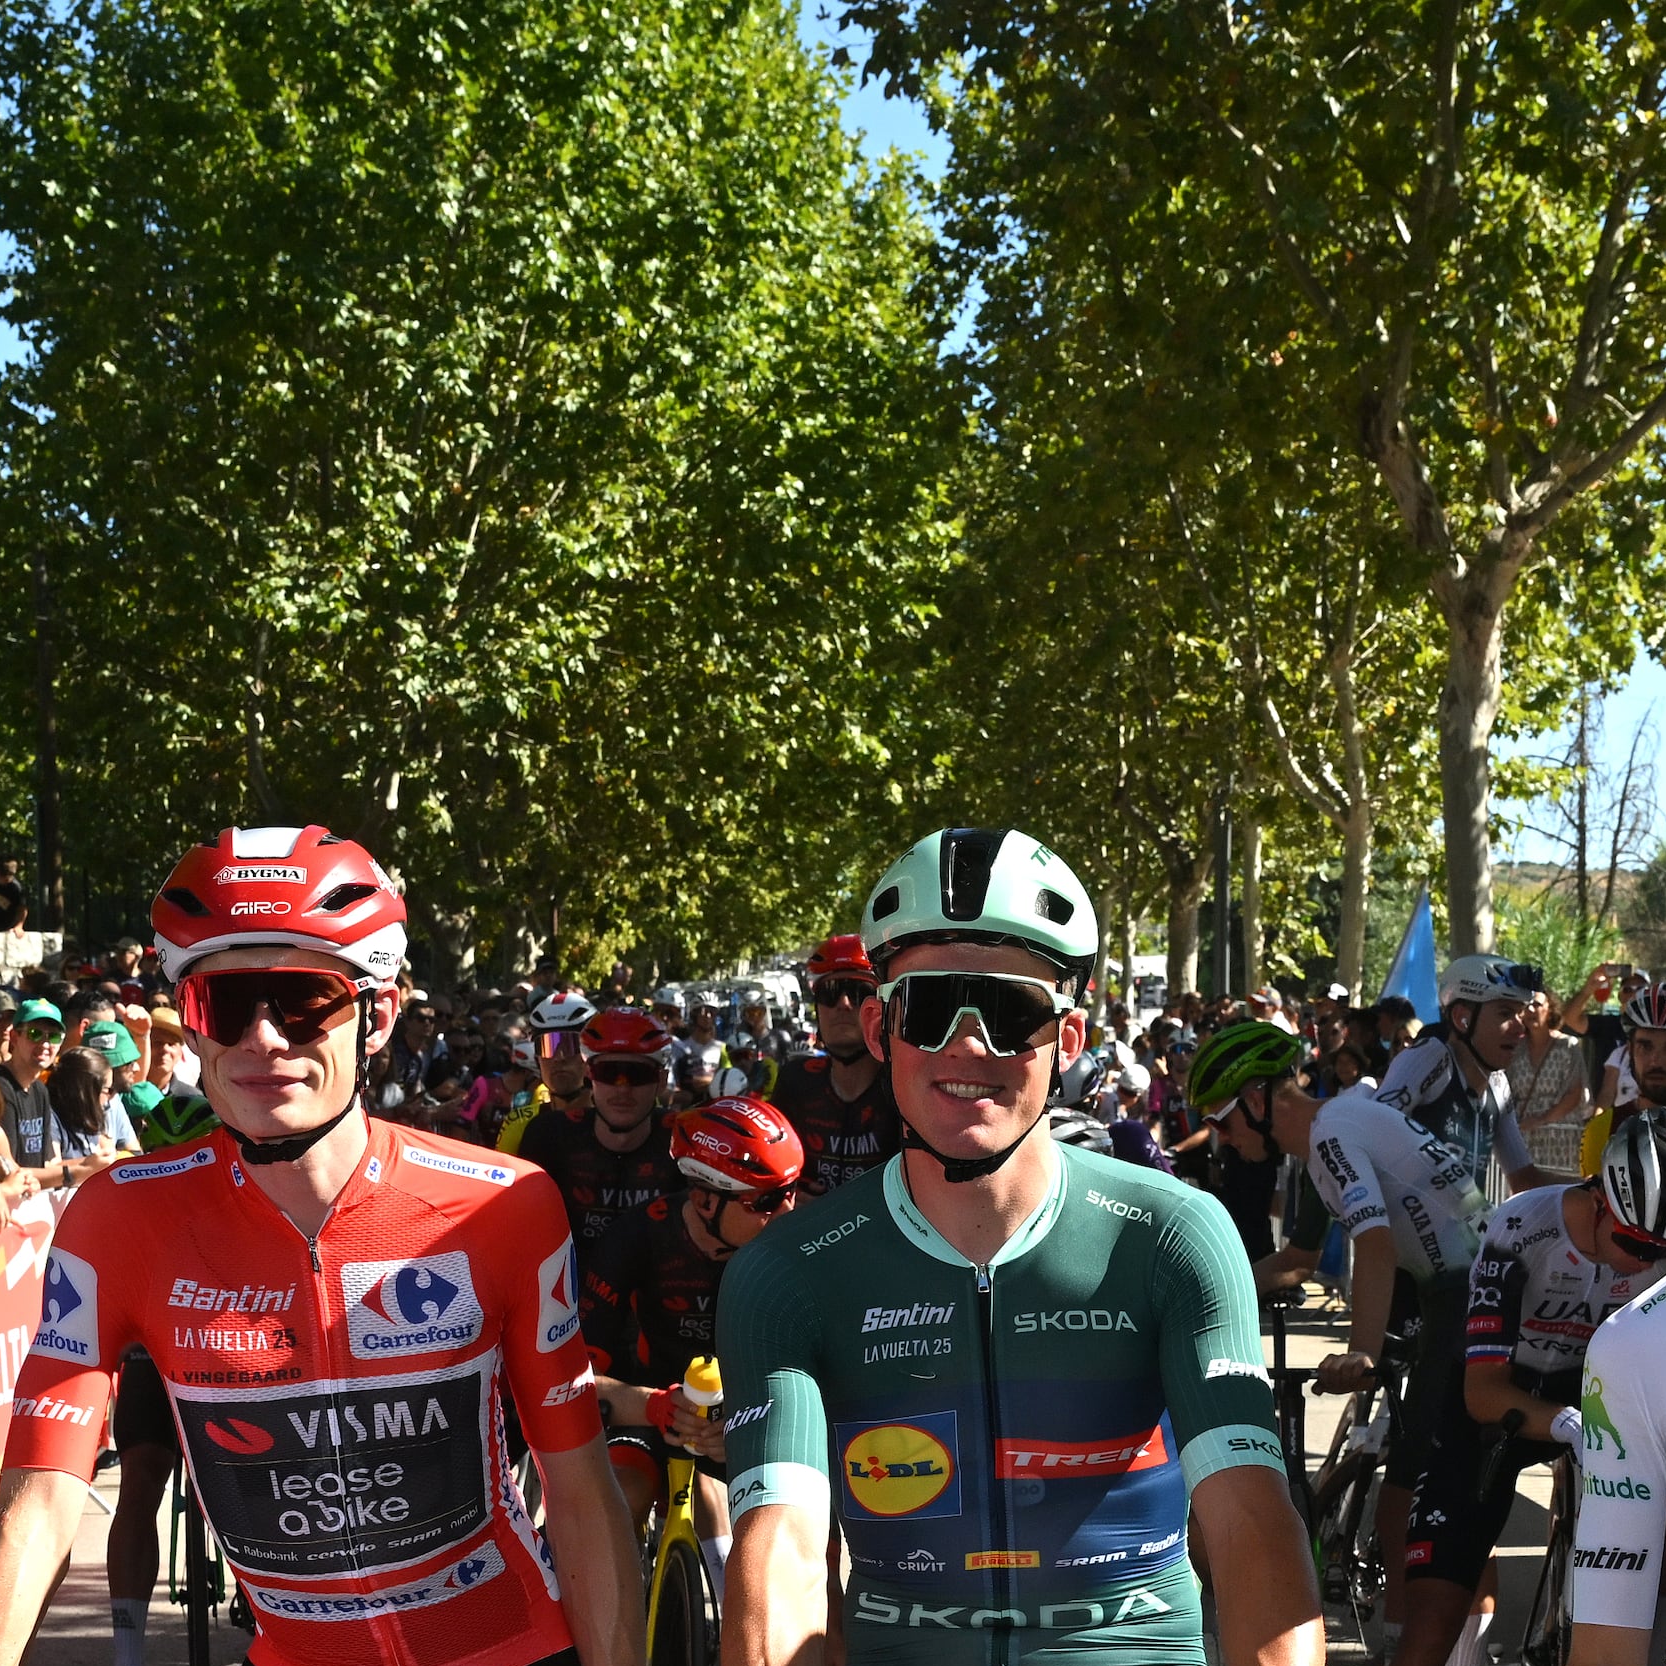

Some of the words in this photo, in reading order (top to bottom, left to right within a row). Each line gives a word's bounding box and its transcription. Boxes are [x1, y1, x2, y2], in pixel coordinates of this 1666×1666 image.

[238, 868, 300, 880] BYGMA
[231, 902, 291, 915] GIRO
[692, 1130, 732, 1156] GIRO
[830, 1132, 881, 1156] VISMA
[119, 1162, 187, 1180] Carrefour
[410, 1150, 479, 1176] Carrefour
[1522, 1226, 1559, 1250] Analog
[167, 1278, 297, 1312] Santini
[861, 1301, 956, 1333] Santini
[33, 1331, 89, 1357] rrefour
[174, 1327, 194, 1348] LA
[197, 1330, 269, 1351] VUELTA
[273, 1328, 298, 1350] 25
[362, 1322, 474, 1351] Carrefour
[864, 1340, 881, 1364] LA
[882, 1338, 930, 1362] VUELTA
[933, 1337, 953, 1356] 25
[287, 1397, 452, 1449] VISMA
[1004, 1439, 1153, 1468] TREK
[269, 1462, 405, 1502] lease
[244, 1549, 299, 1563] Rabobank
[388, 1527, 443, 1551] SRAM
[897, 1560, 947, 1573] CRIVIT
[1055, 1551, 1127, 1568] SRAM
[1138, 1529, 1181, 1557] Santini
[256, 1587, 433, 1615] Carrefour
